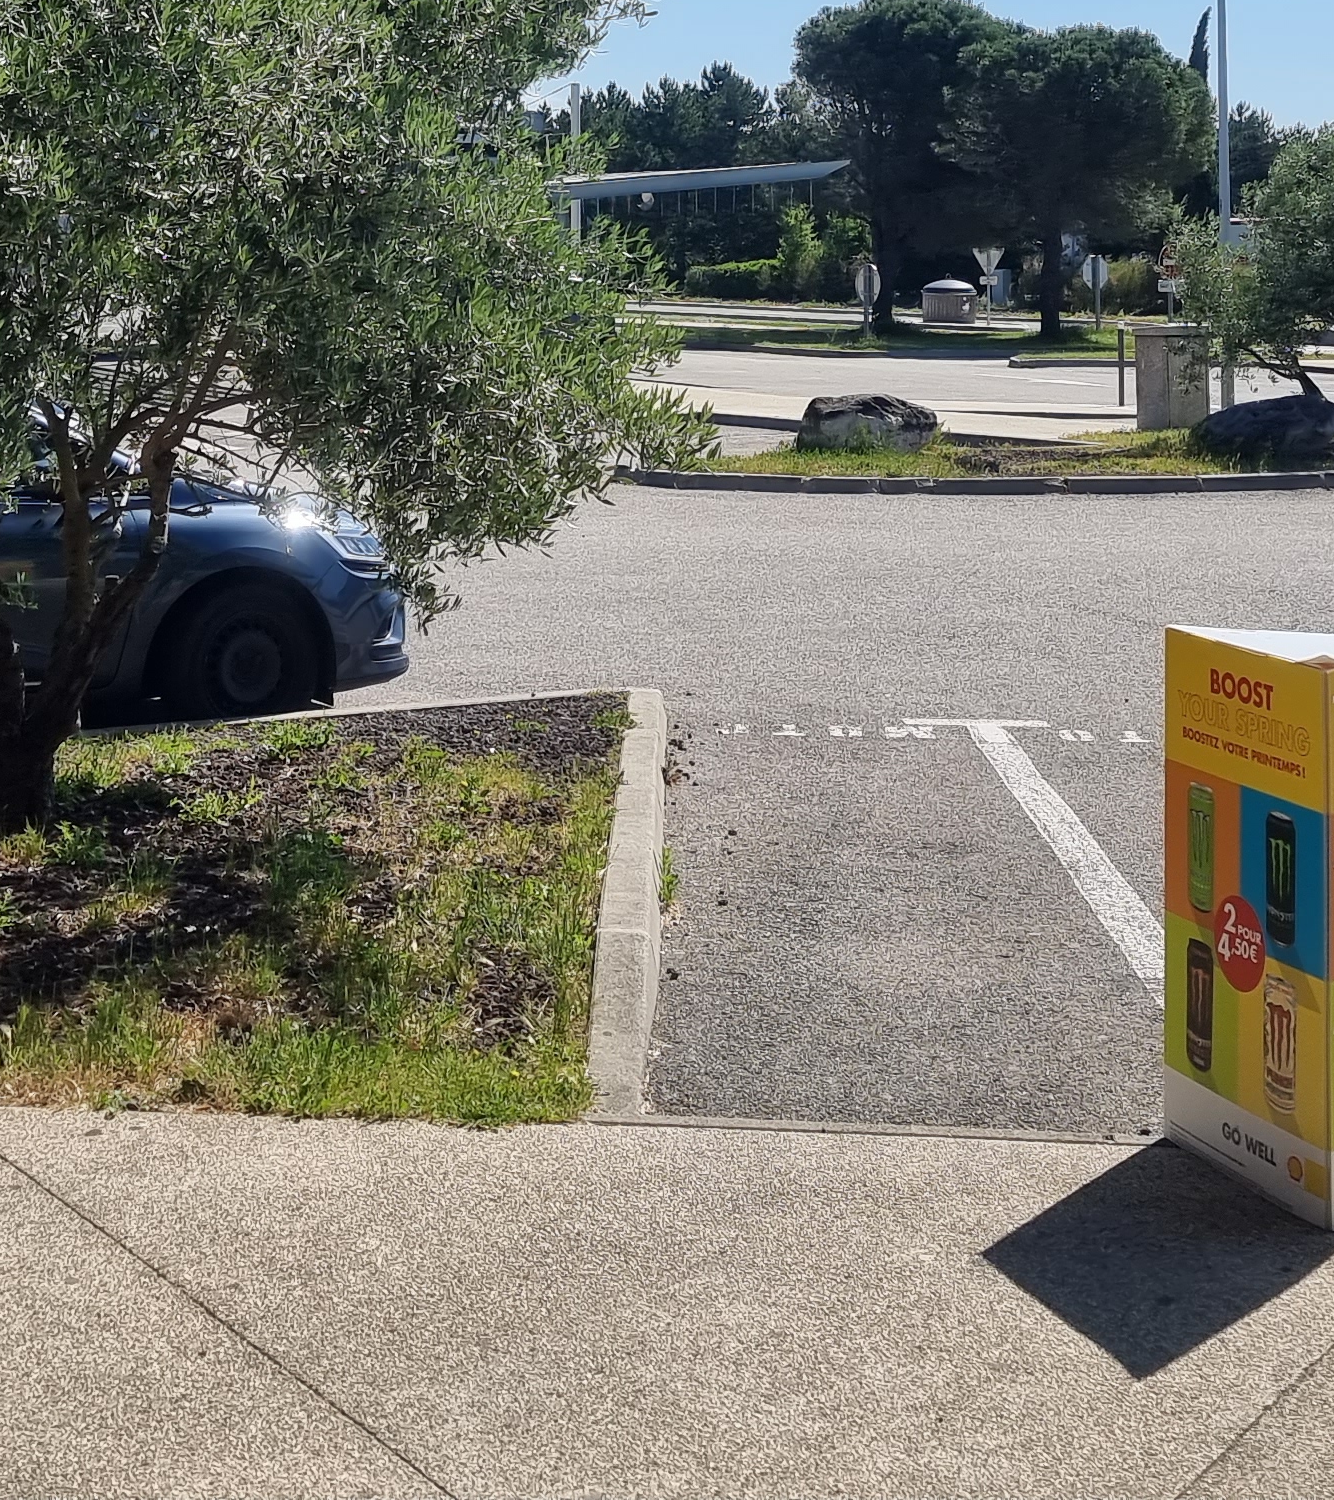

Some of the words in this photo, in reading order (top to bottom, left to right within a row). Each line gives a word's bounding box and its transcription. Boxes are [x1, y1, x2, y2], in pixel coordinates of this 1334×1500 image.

[1210, 668, 1274, 711] BOOST
[1177, 689, 1230, 732] YOUR
[1235, 708, 1311, 757] SPRING
[1182, 726, 1220, 750] BOOSTEZ
[1221, 740, 1249, 760] VOTRE
[1223, 902, 1237, 934] 2
[1237, 924, 1262, 946] POUR
[1217, 932, 1258, 963] 4,50€
[1222, 1121, 1241, 1146] GO
[1245, 1133, 1277, 1167] WELL
